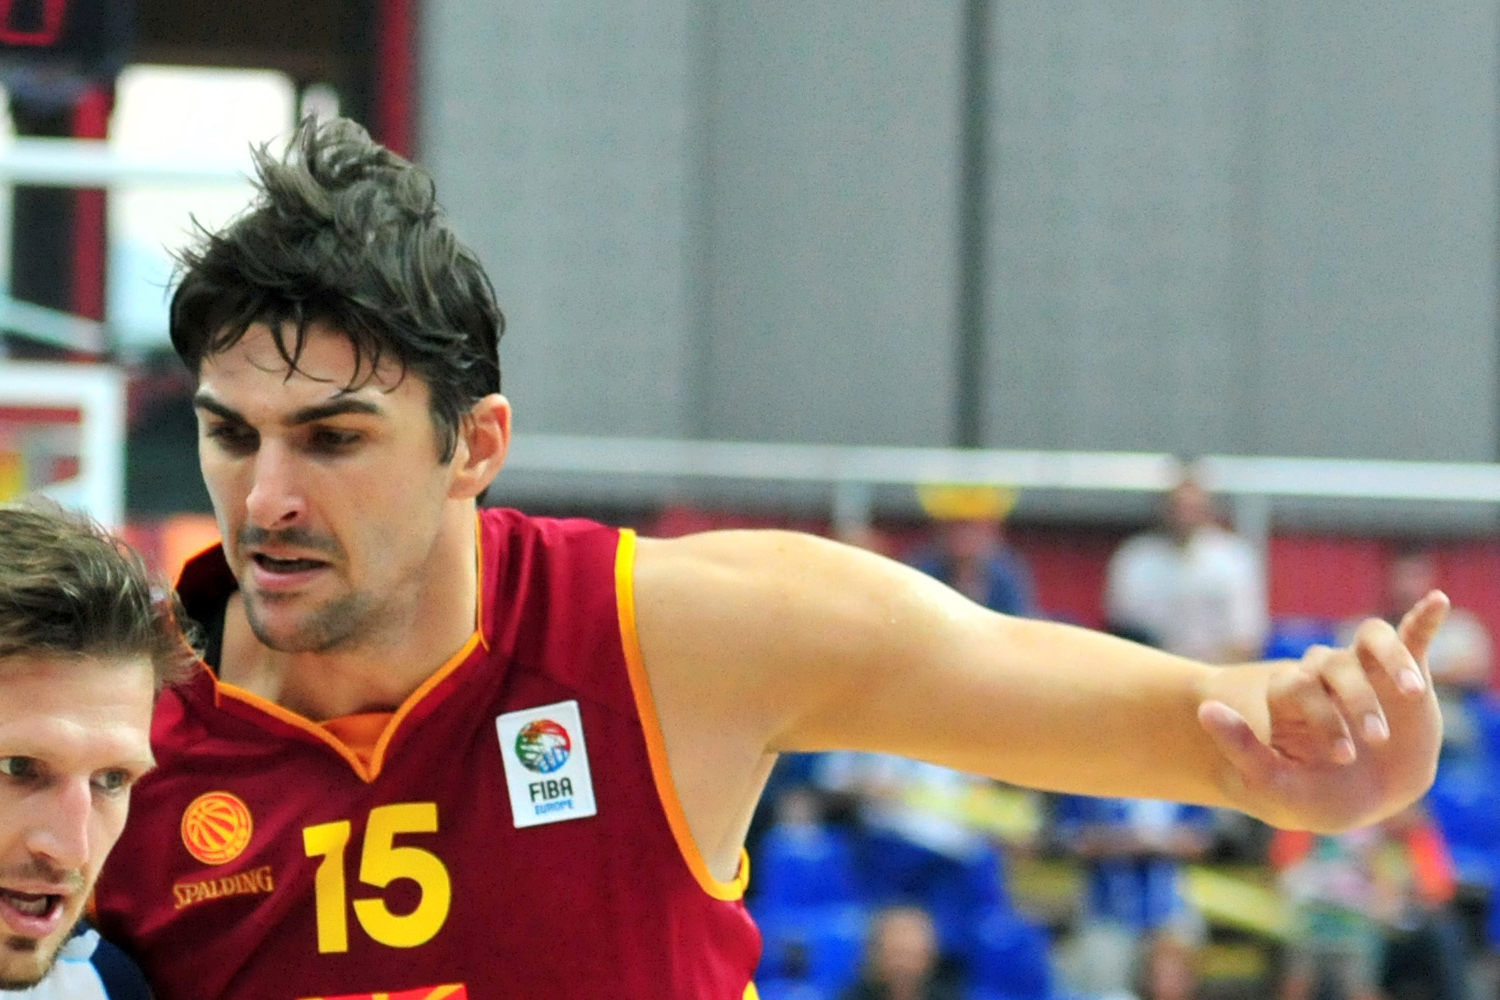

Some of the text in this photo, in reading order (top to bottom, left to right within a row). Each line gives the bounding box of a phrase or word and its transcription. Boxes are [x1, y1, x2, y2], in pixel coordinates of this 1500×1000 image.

[528, 777, 574, 803] FIBA
[173, 865, 274, 909] SPALDING
[303, 803, 451, 954] 15
